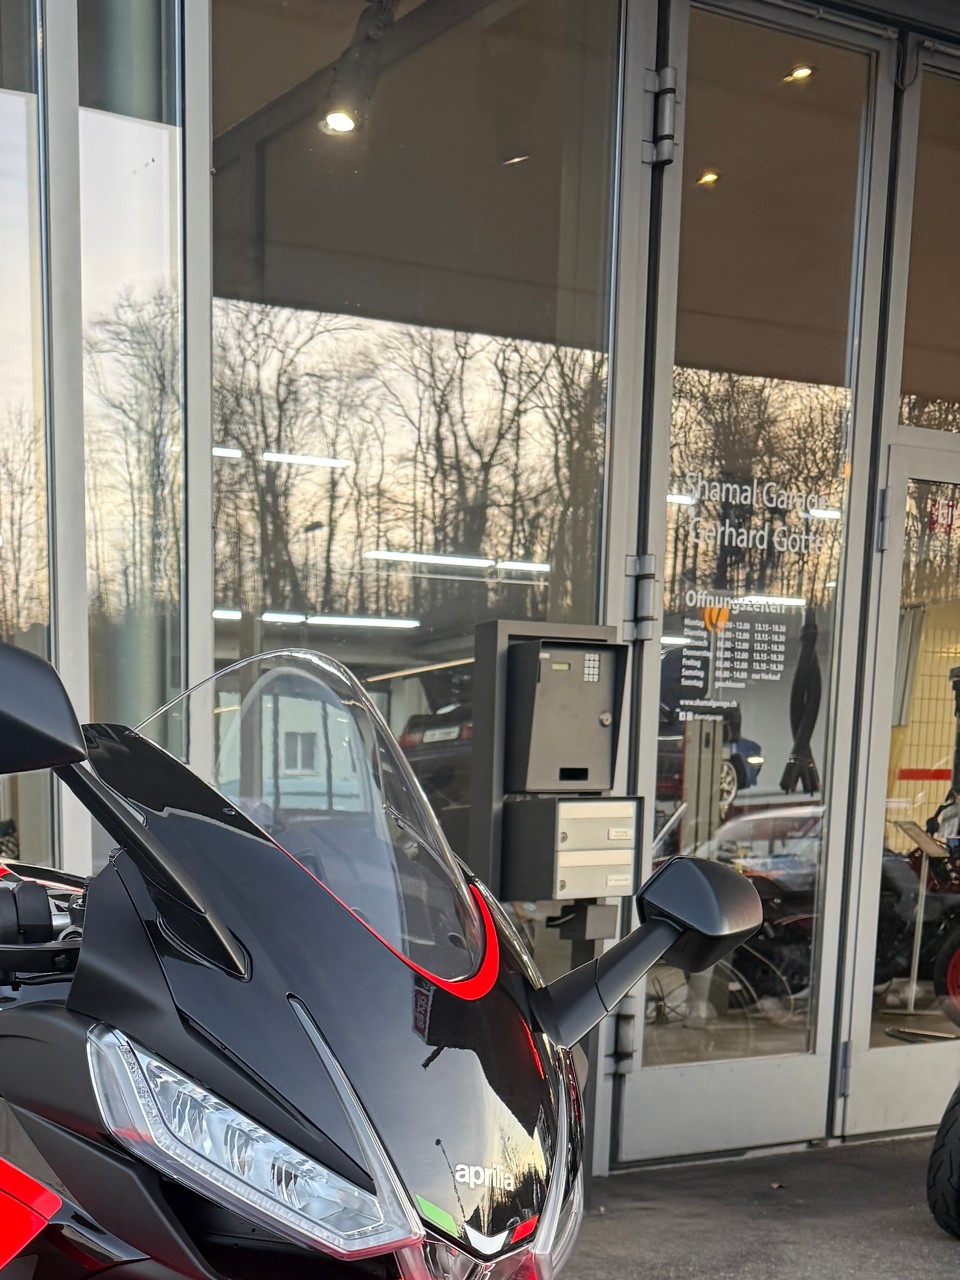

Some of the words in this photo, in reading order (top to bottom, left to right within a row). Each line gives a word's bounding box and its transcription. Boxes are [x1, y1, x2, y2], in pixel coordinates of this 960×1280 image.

[686, 472, 757, 505] Shamal
[763, 482, 829, 512] Garage
[691, 518, 768, 549] Gerhard
[455, 1163, 515, 1191] aprilia
